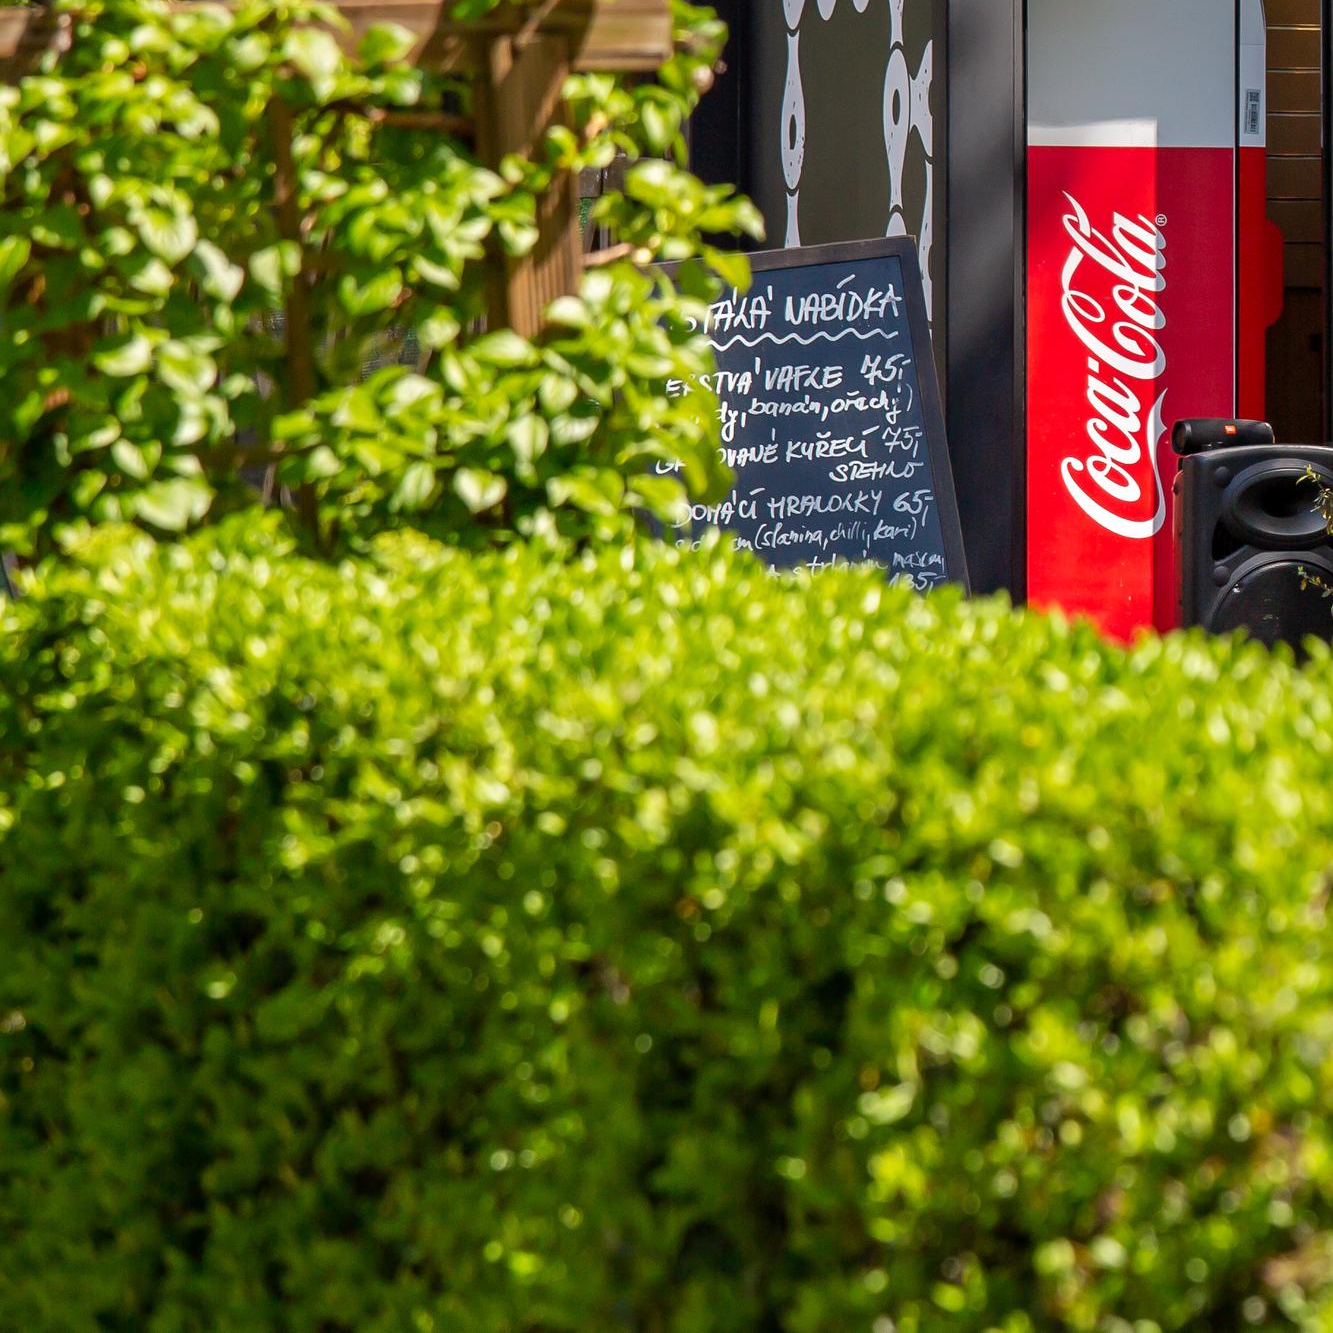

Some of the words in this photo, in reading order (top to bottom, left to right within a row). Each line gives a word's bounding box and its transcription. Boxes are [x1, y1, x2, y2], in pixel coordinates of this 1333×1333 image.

[785, 274, 903, 326] NABÍDKA
[765, 364, 844, 392] VAFLE
[1061, 190, 1167, 540] Coca-Cola
